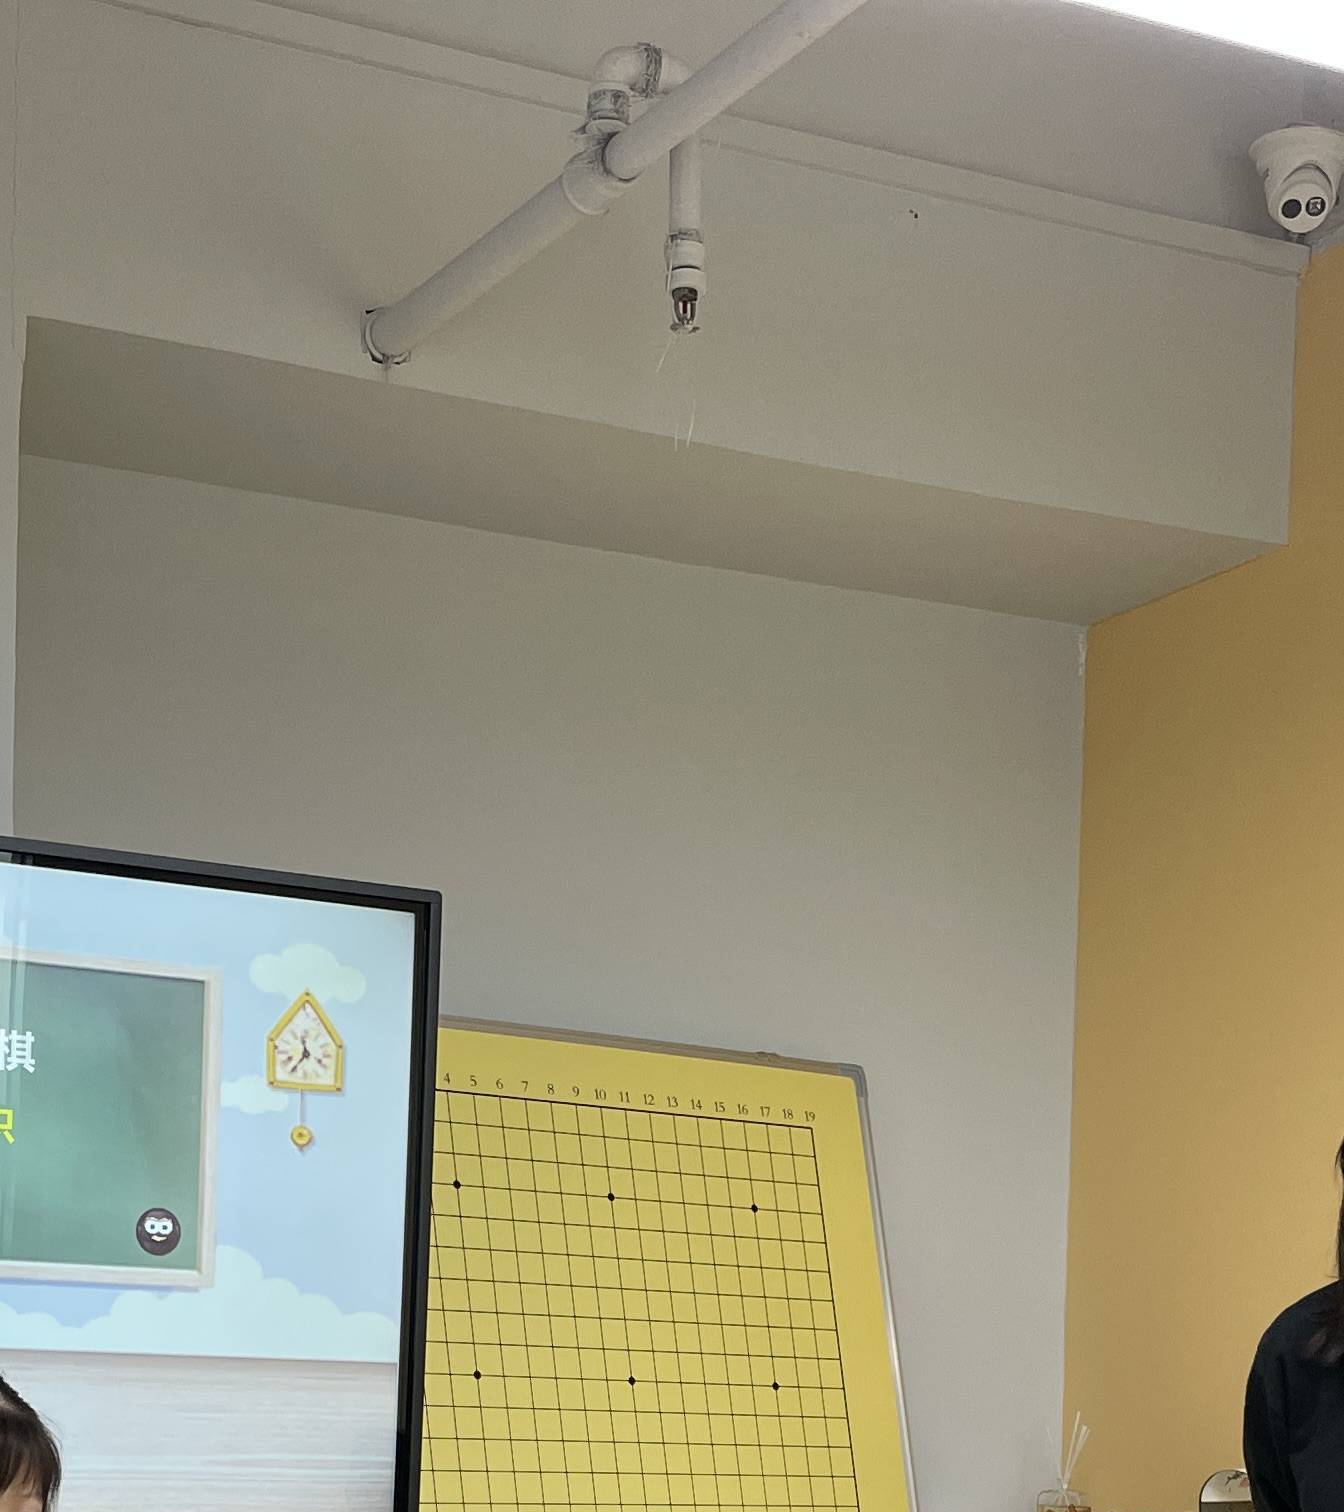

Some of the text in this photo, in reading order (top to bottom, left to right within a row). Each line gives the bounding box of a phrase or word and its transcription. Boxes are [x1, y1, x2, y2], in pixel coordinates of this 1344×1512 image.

[443, 1073, 816, 1122] 4 5 6 7 8 9 10 11 12 13 14 15 16 17 18 19
